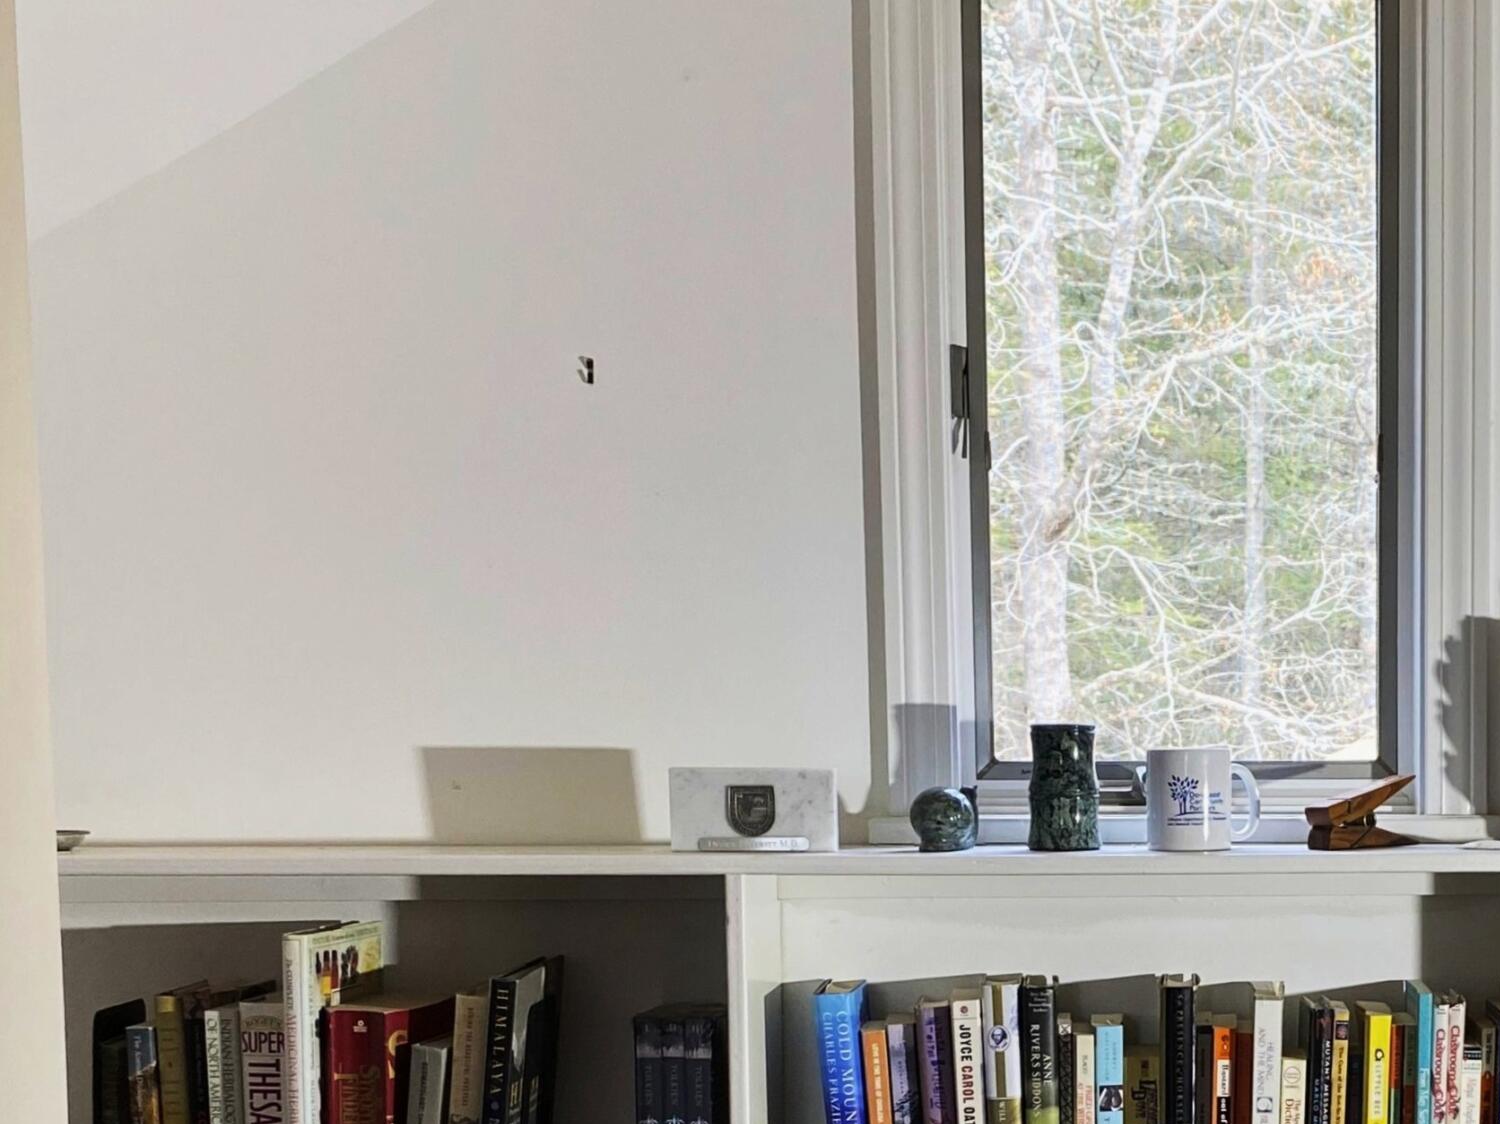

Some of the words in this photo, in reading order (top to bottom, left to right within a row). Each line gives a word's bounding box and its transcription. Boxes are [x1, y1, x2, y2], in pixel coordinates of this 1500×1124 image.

[206, 1018, 218, 1034] OF
[220, 1018, 232, 1060] INDIAN
[242, 1032, 285, 1053] SUPER
[489, 988, 510, 1095] HIMALAYA
[823, 1011, 837, 1074] CHARLES
[835, 1010, 850, 1061] COLD
[959, 1024, 973, 1062] JOYCE
[1029, 1024, 1041, 1068] RIVERS
[208, 1036, 220, 1079] NORTH
[287, 1013, 299, 1085] MEDICINAL
[1323, 1040, 1331, 1080] MUTANT
[962, 1065, 975, 1103] CAROL
[1042, 1054, 1052, 1086] ANNE
[1220, 1063, 1230, 1096] Bastard
[998, 1101, 1008, 1122] WILL
[1031, 1071, 1042, 1118] SIDDONS
